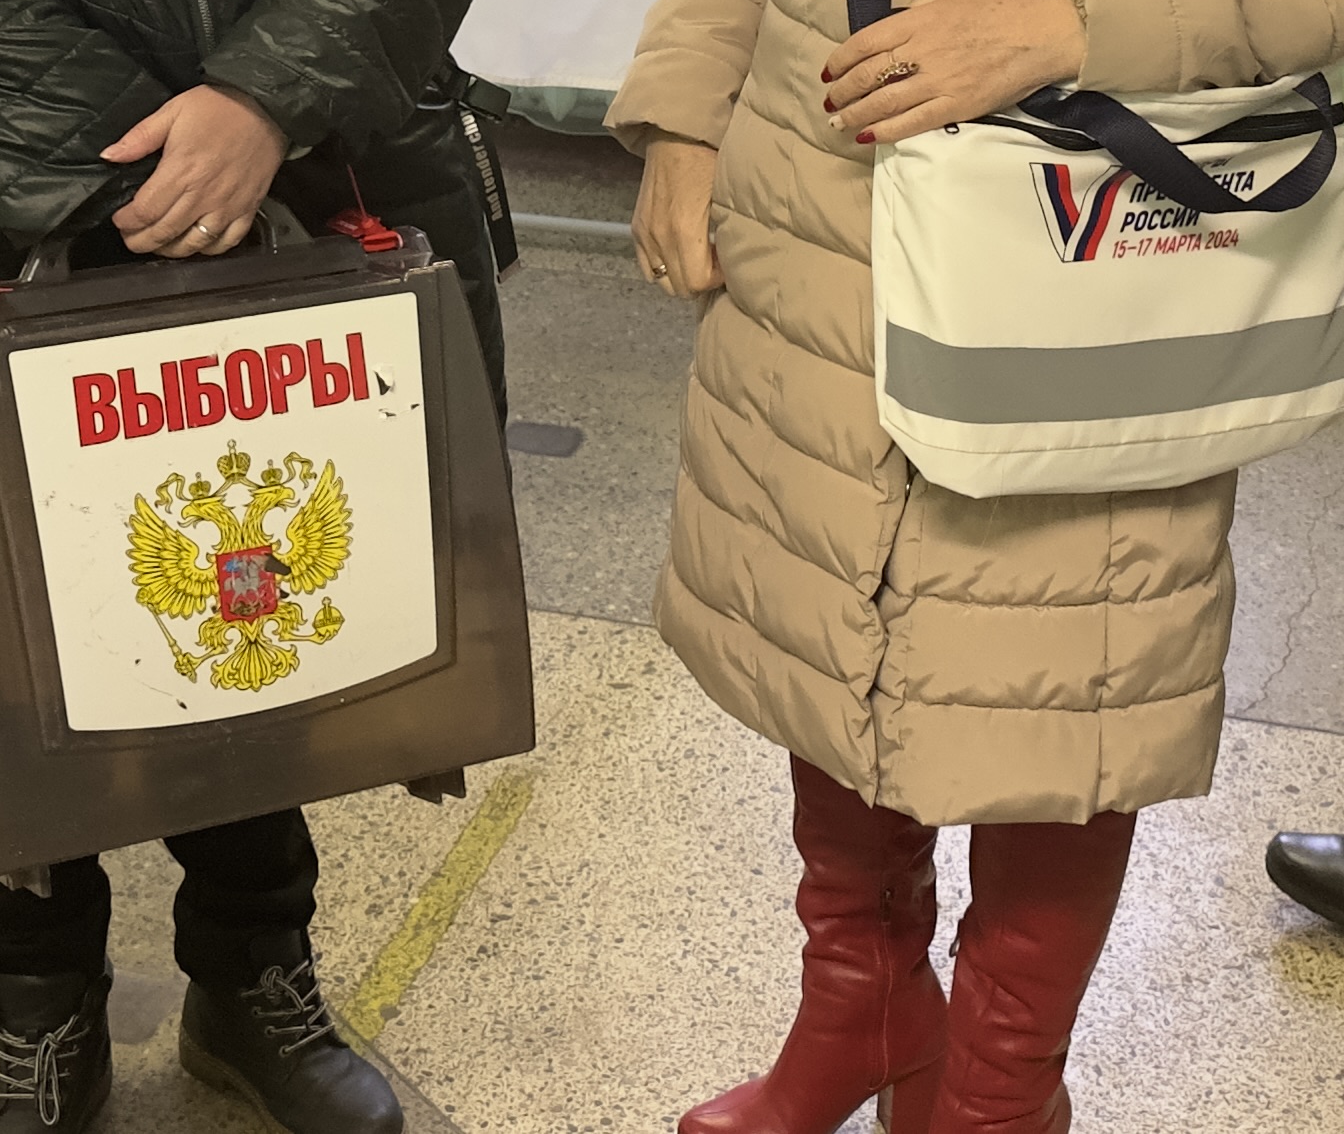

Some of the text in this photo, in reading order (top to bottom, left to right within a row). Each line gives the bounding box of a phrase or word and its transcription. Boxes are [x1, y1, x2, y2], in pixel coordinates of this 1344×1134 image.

[472, 145, 497, 194] tender
[1120, 207, 1201, 233] РОССИИ
[1154, 232, 1203, 256] МАРТА
[1204, 228, 1240, 250] 2024
[72, 332, 371, 448] ВЫБОРЫ
